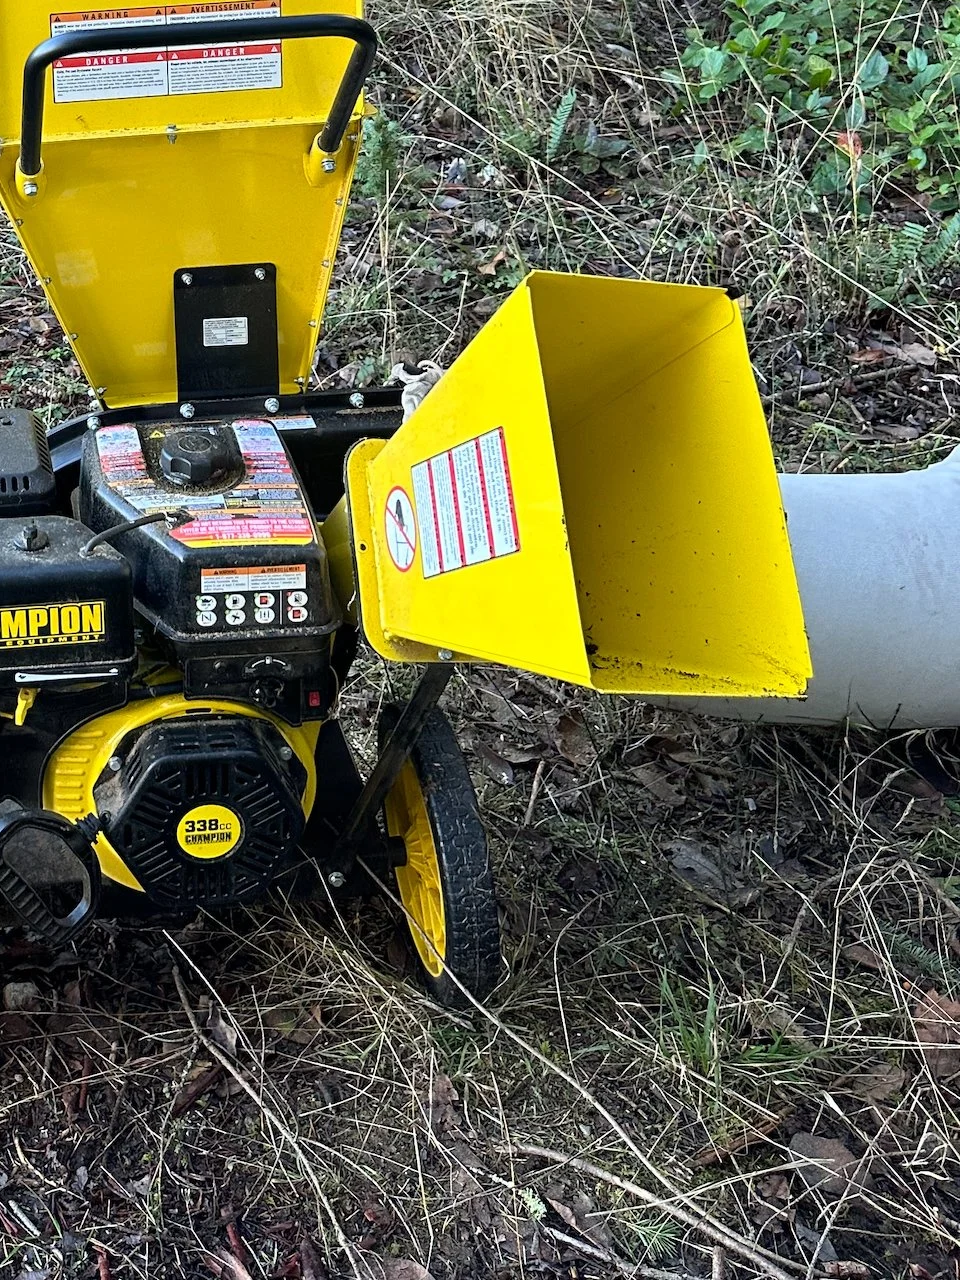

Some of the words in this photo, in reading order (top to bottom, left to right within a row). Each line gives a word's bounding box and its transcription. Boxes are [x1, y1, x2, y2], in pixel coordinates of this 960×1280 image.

[190, 2, 256, 14] AVERTISSEMENT
[82, 11, 129, 21] WARNING
[202, 47, 245, 58] DANGER
[86, 56, 129, 66] DANGER
[6, 635, 101, 646] EQUIPMENT
[185, 832, 232, 844] CHAMPION
